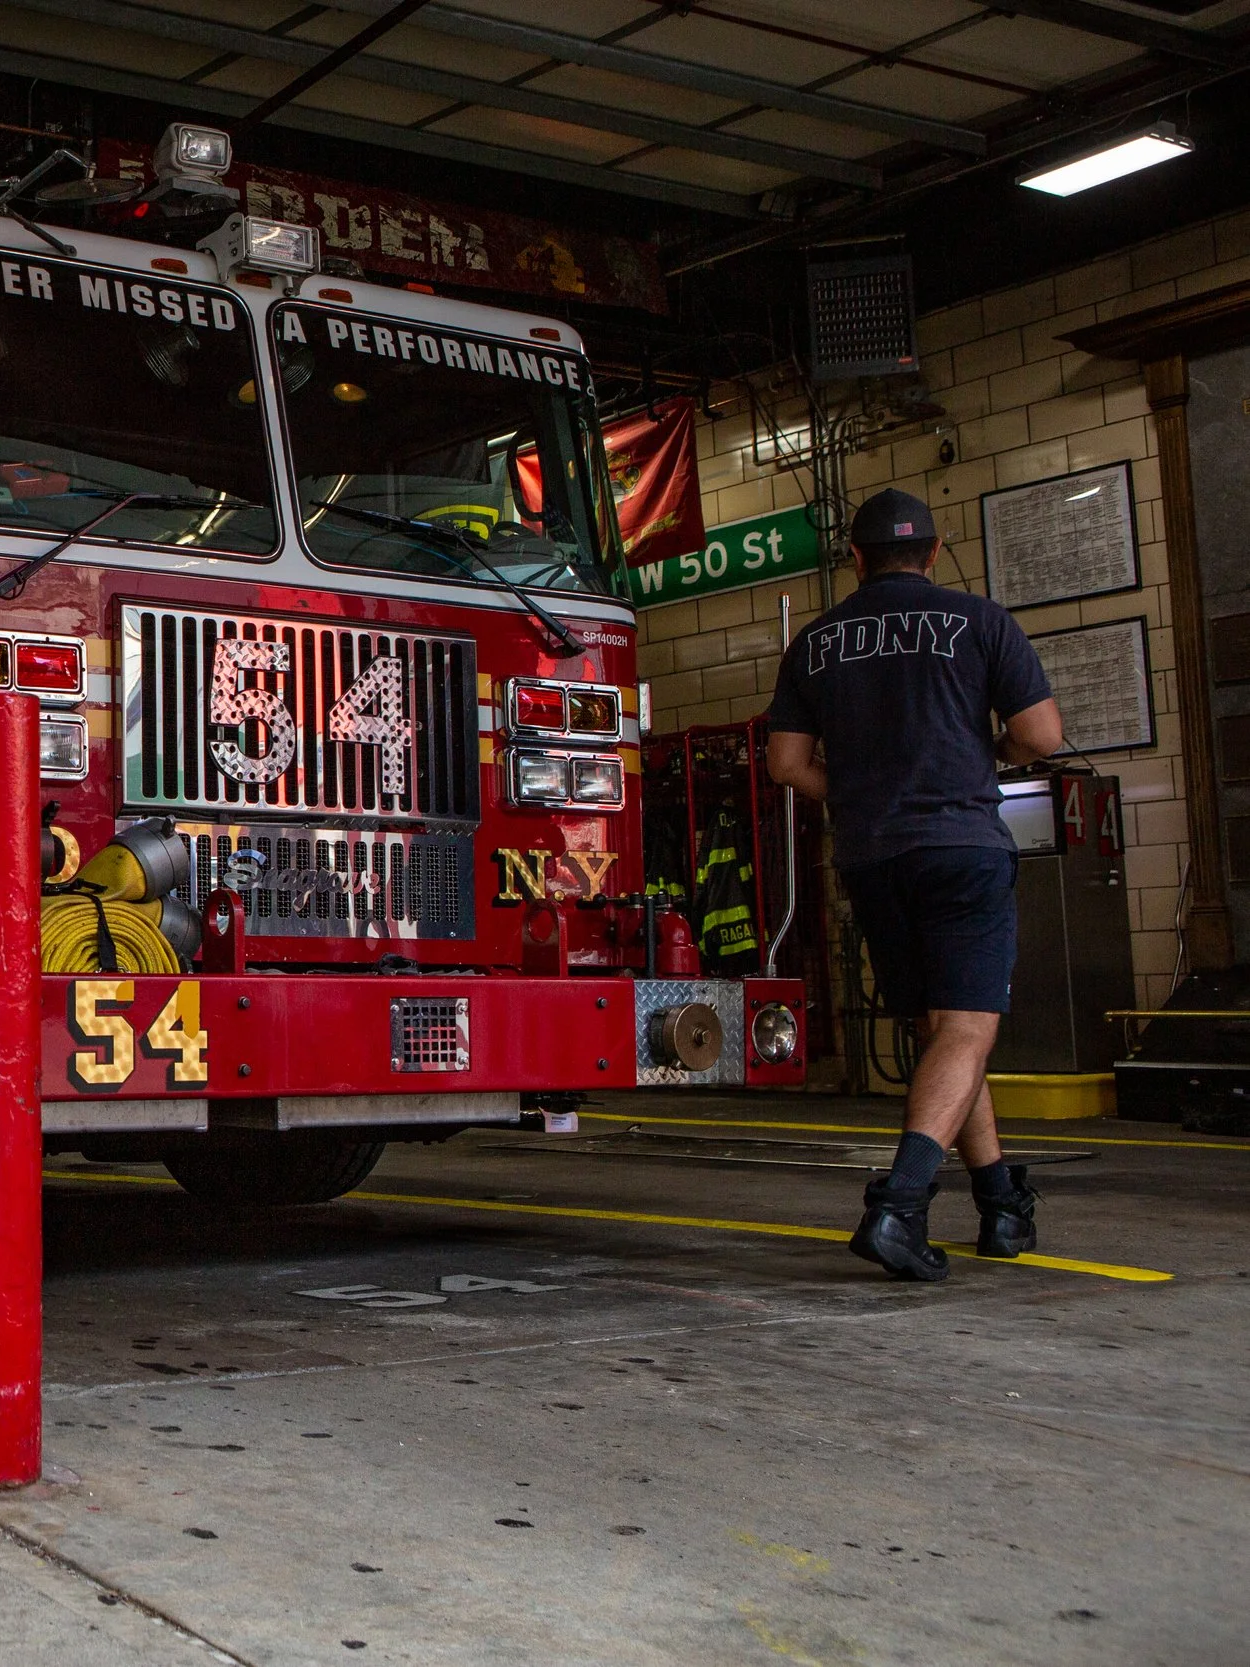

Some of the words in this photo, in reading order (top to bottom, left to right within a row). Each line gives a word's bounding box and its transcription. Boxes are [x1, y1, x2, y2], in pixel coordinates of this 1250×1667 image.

[78, 273, 237, 332] MISSED
[283, 311, 307, 344] A
[326, 317, 582, 392] PERFORMANCE
[638, 560, 664, 595] W
[679, 541, 728, 585] 50
[742, 526, 784, 570] St
[583, 631, 628, 648] SP14002H
[807, 611, 968, 676] FDNY
[209, 638, 412, 796] 54
[1063, 780, 1084, 838] 4
[1100, 793, 1119, 851] 4
[224, 848, 380, 913] Seagrave
[720, 922, 754, 943] RAGA
[74, 979, 208, 1086] 54
[291, 1273, 571, 1309] 54
